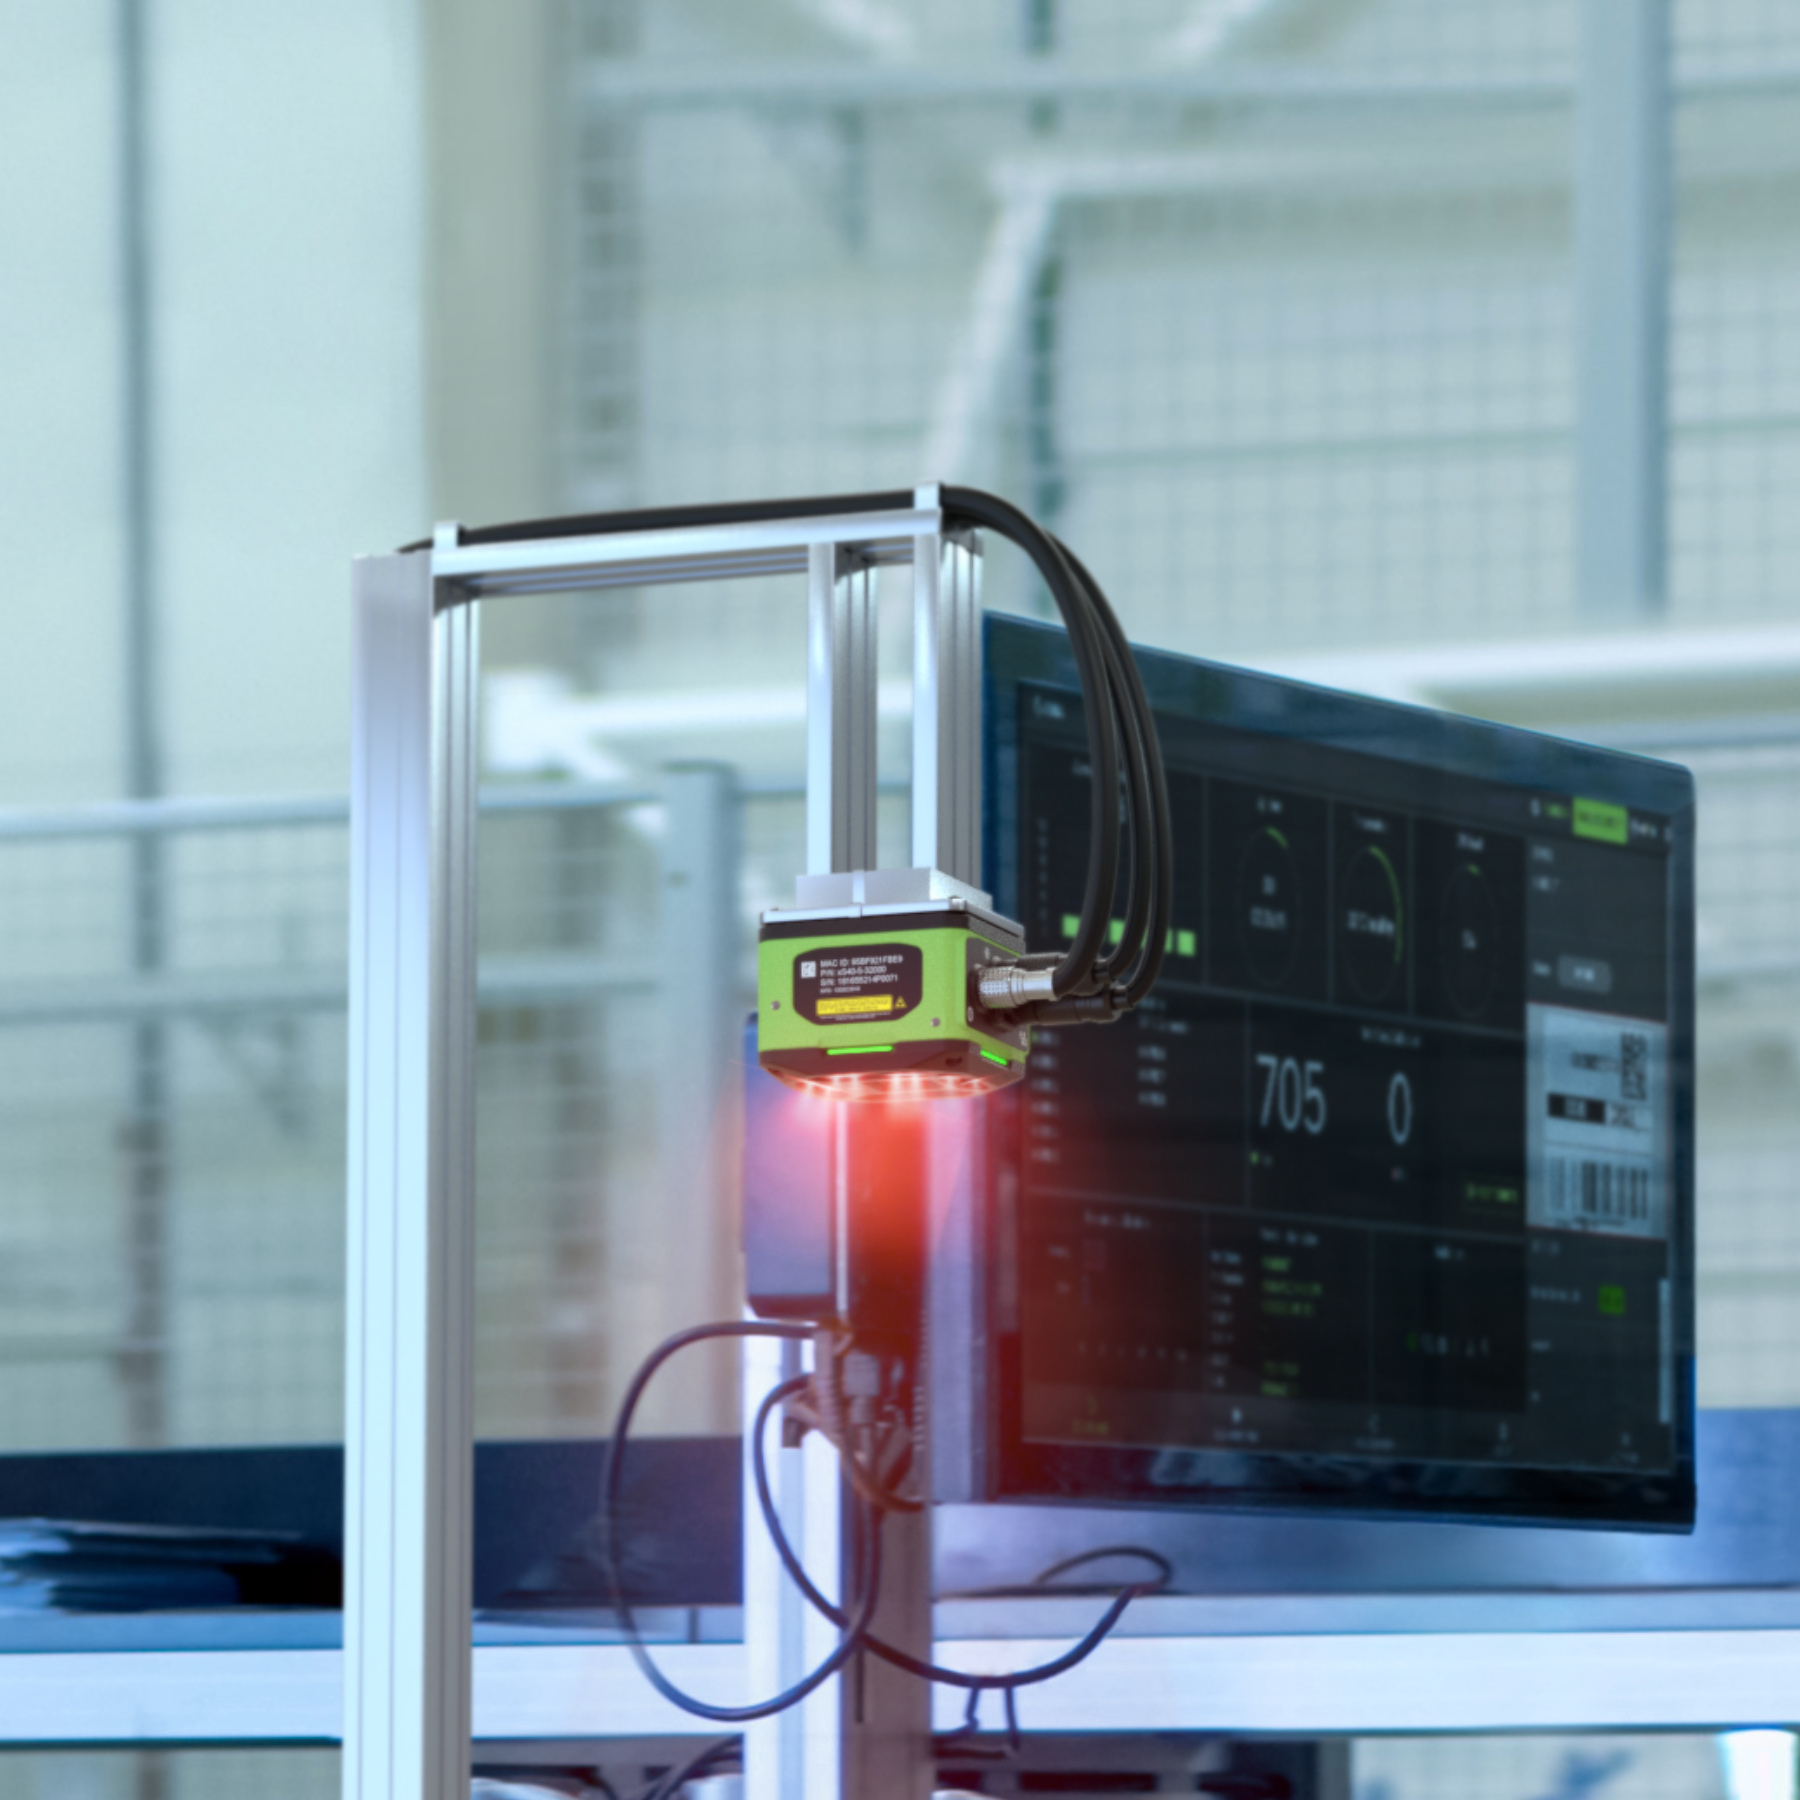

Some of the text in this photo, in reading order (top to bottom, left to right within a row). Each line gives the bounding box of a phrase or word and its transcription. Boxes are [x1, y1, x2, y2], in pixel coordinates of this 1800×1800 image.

[820, 959, 838, 967] MAC
[1256, 1055, 1326, 1135] 705
[1388, 1073, 1412, 1145] 0
